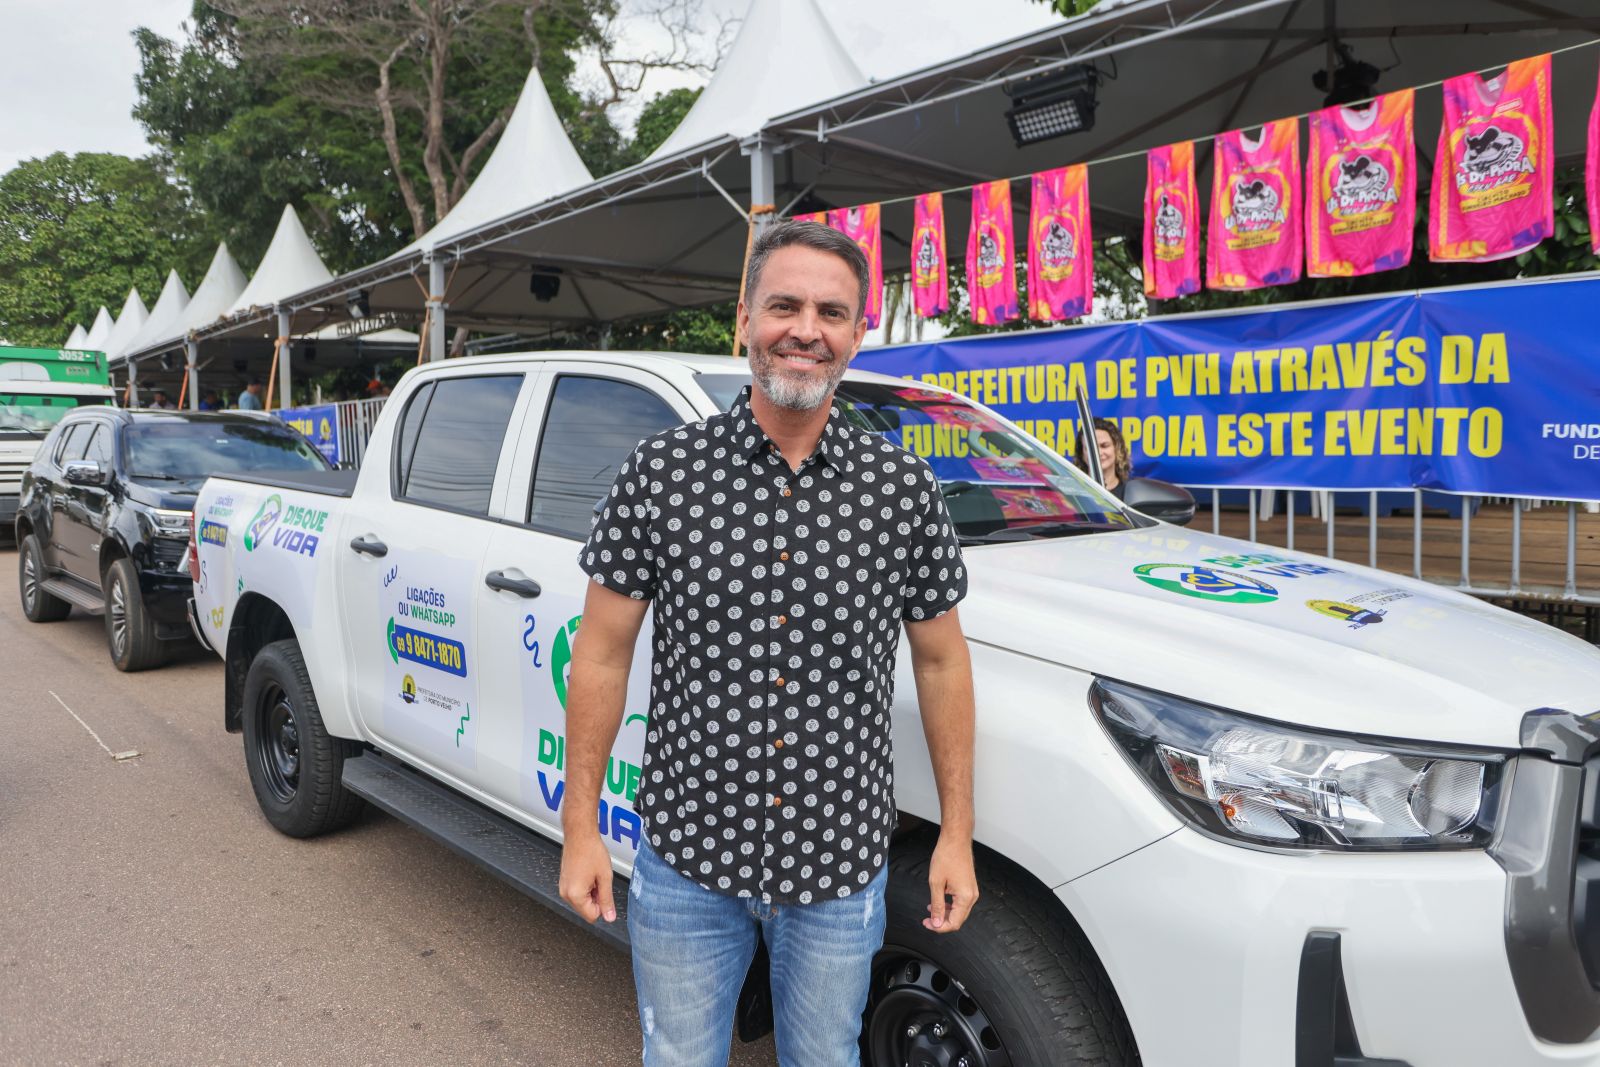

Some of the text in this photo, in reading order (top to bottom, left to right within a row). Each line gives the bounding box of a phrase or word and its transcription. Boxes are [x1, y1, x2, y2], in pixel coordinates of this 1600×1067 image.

[58, 350, 85, 361] 3052
[1096, 357, 1137, 401] DE
[1146, 353, 1220, 397] PVH
[1230, 330, 1426, 395] ATRAVÉS
[1439, 333, 1510, 385] DA
[1113, 415, 1206, 458] POIA
[1216, 410, 1313, 457] ESTE
[1324, 406, 1503, 458] EVENTO
[1542, 423, 1600, 439] FUND
[1573, 444, 1600, 460] DE
[283, 505, 329, 532] DISQUE
[273, 527, 319, 558] VIDA
[406, 586, 445, 608] LIGAÇÕES
[398, 602, 456, 628] OU WHATSAPP
[406, 632, 412, 655] 9
[414, 635, 461, 669] 8471-1870
[537, 728, 642, 802] DIUE
